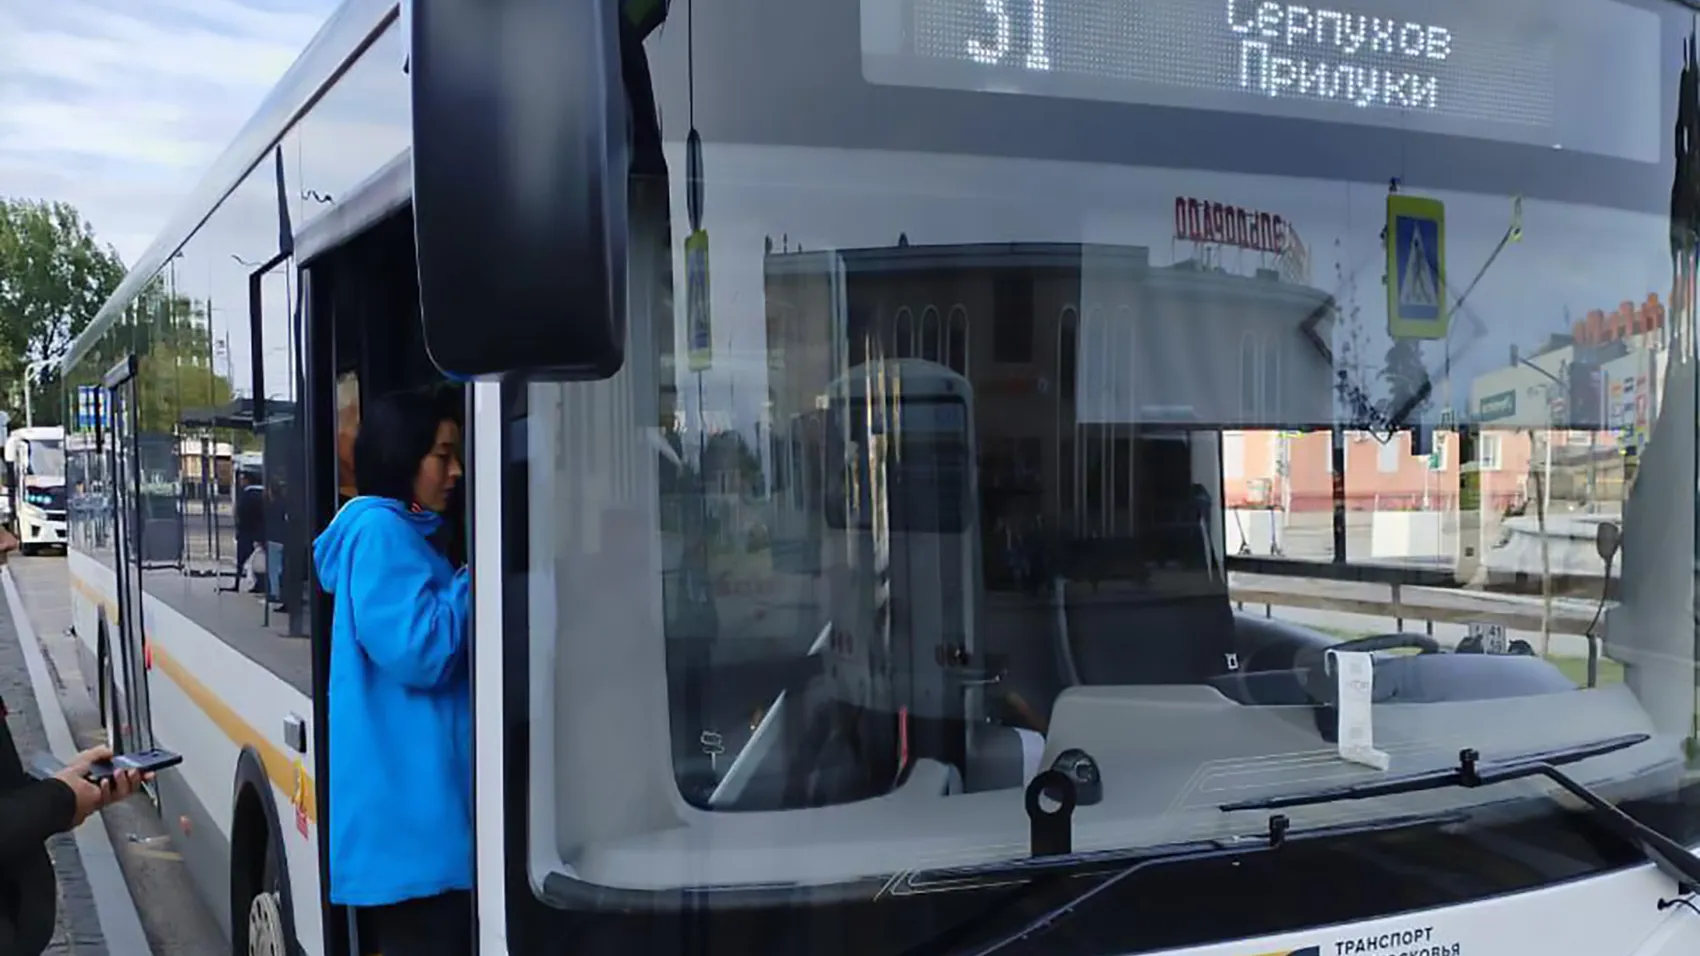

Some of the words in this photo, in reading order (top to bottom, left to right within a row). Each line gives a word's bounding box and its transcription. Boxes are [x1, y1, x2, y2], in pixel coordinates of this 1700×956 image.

[1227, 0, 1452, 60] Серпухов
[1240, 39, 1437, 108] Прилуки
[1335, 926, 1433, 955] ТРАНСПОРТ
